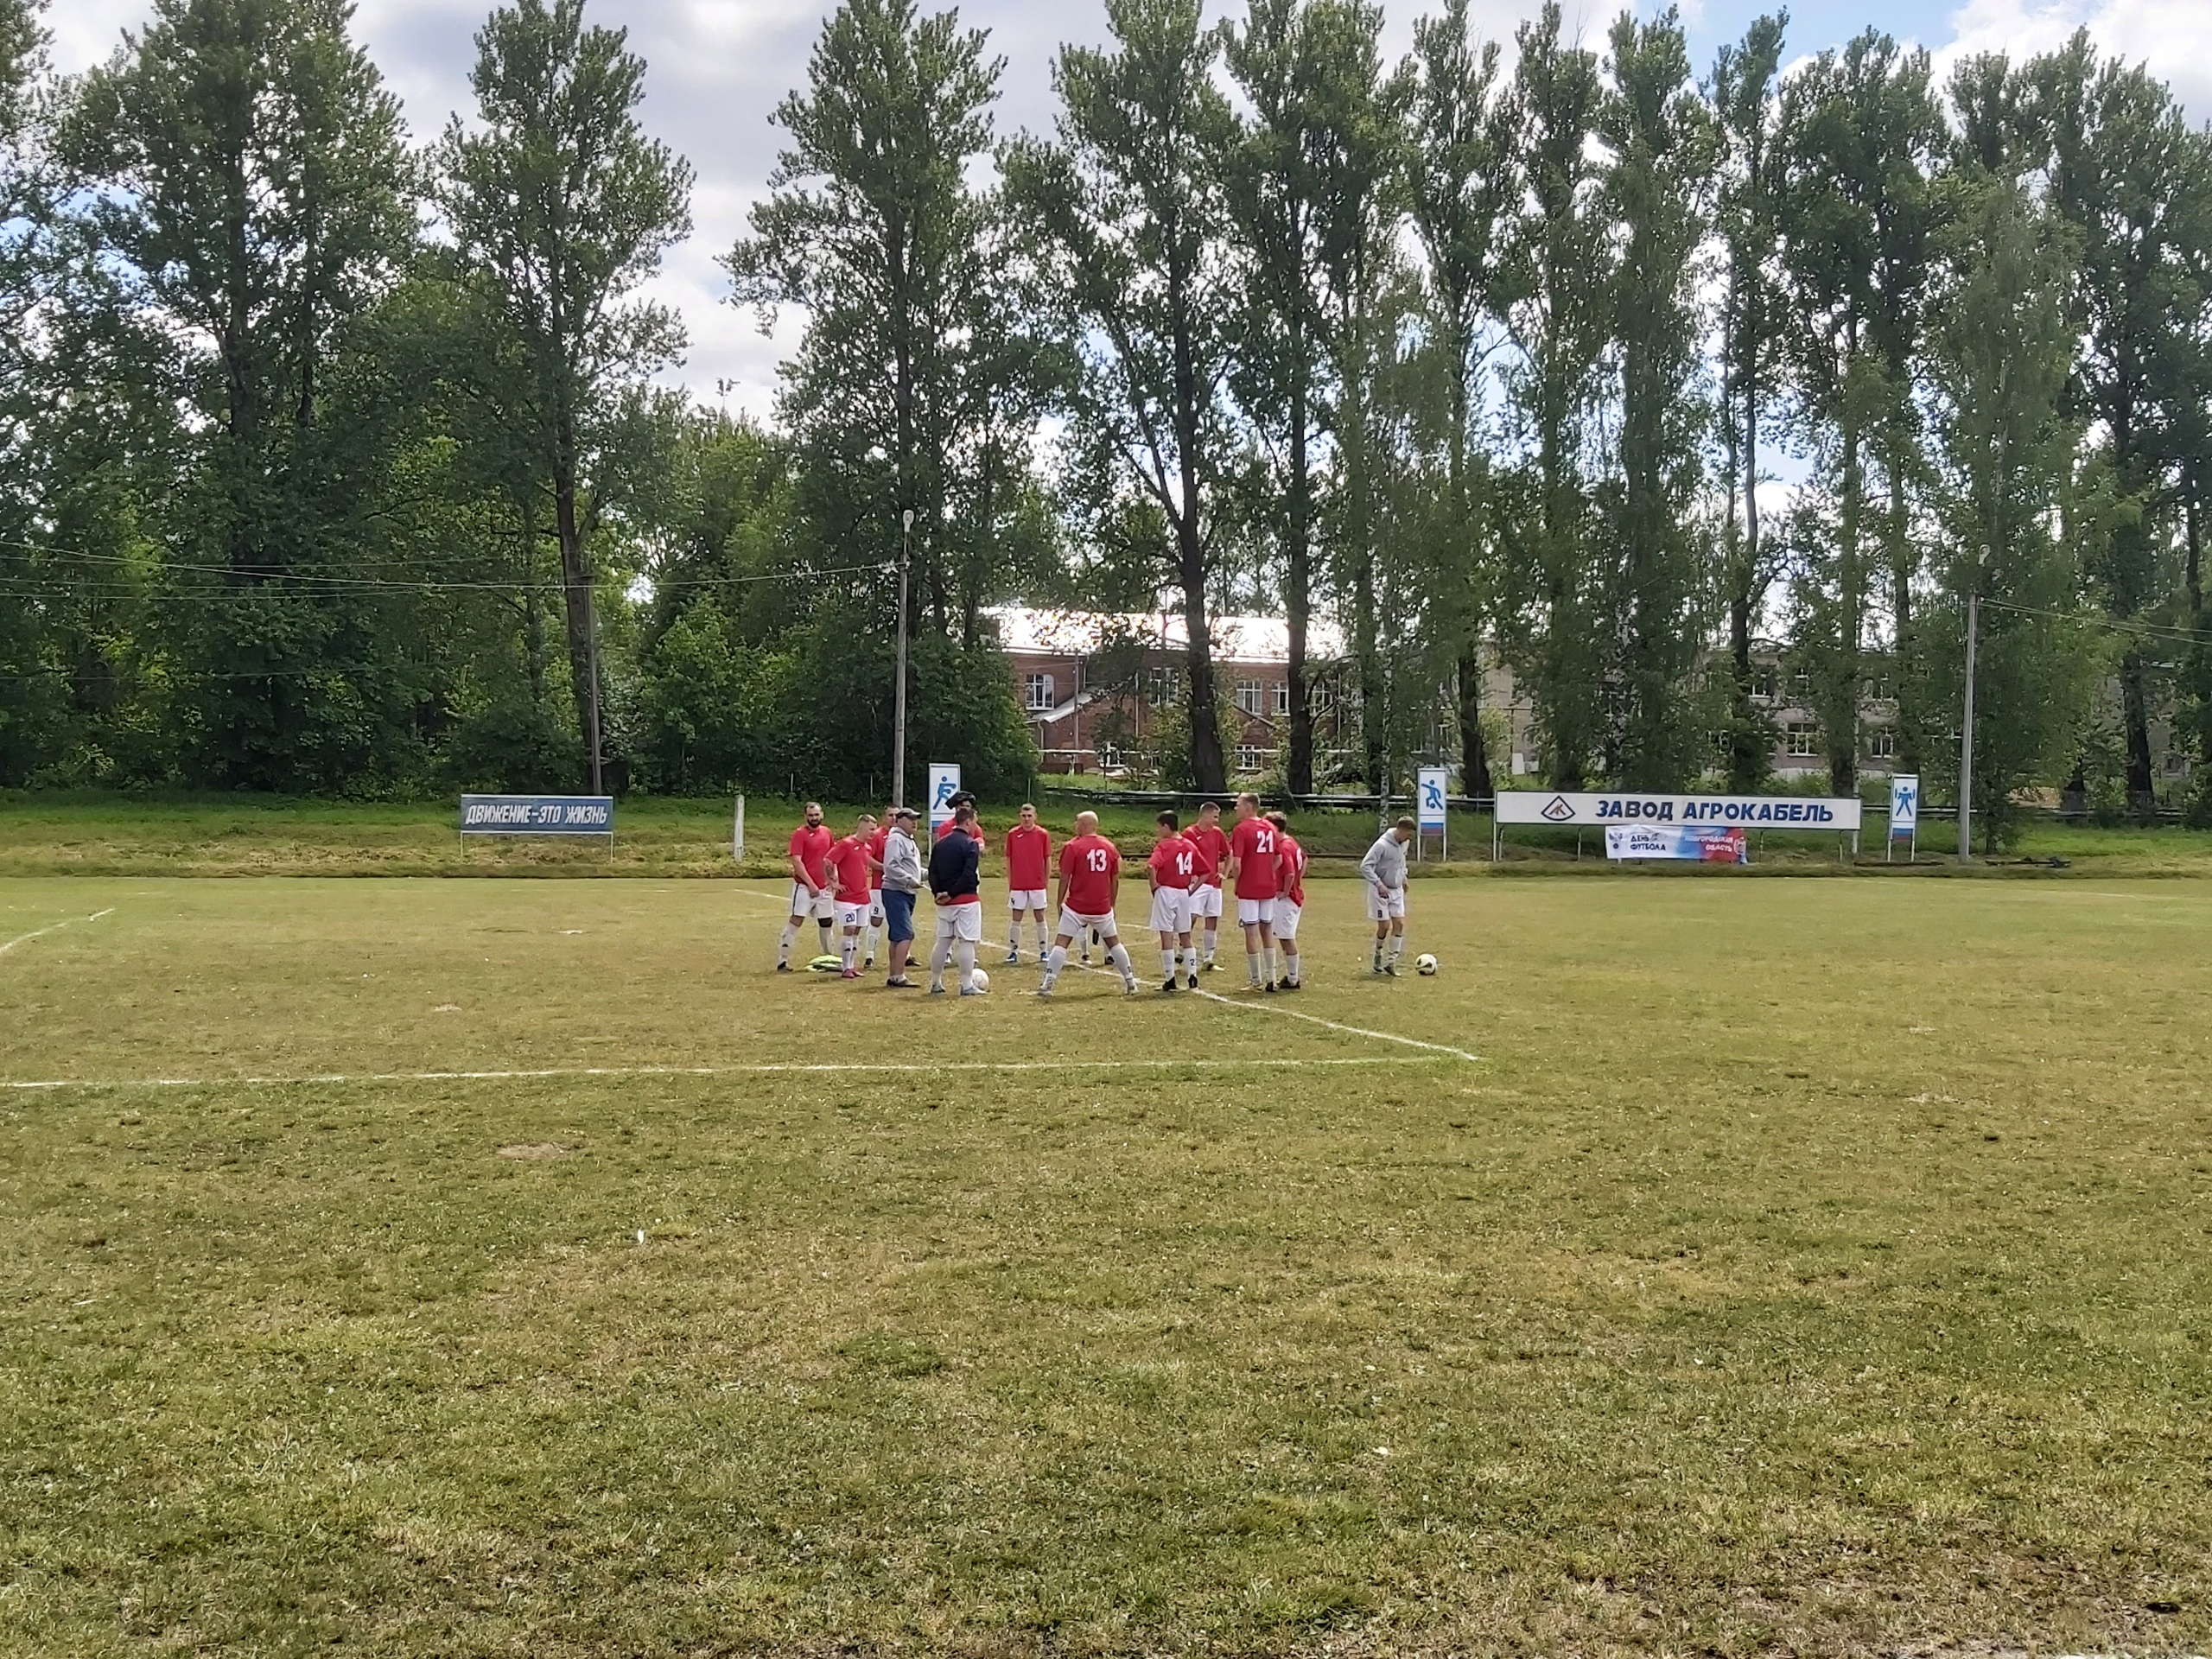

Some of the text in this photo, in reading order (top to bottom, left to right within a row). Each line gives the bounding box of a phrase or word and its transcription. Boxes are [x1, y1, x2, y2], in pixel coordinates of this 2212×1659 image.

[564, 805, 608, 824] ЖИЗНЬ
[1595, 800, 1834, 823] ЗАВОД АГРОКАБЕЛЬ
[1256, 830, 1274, 854] 21
[1086, 849, 1107, 872] 13
[1175, 851, 1193, 875] 14
[845, 912, 855, 923] 20
